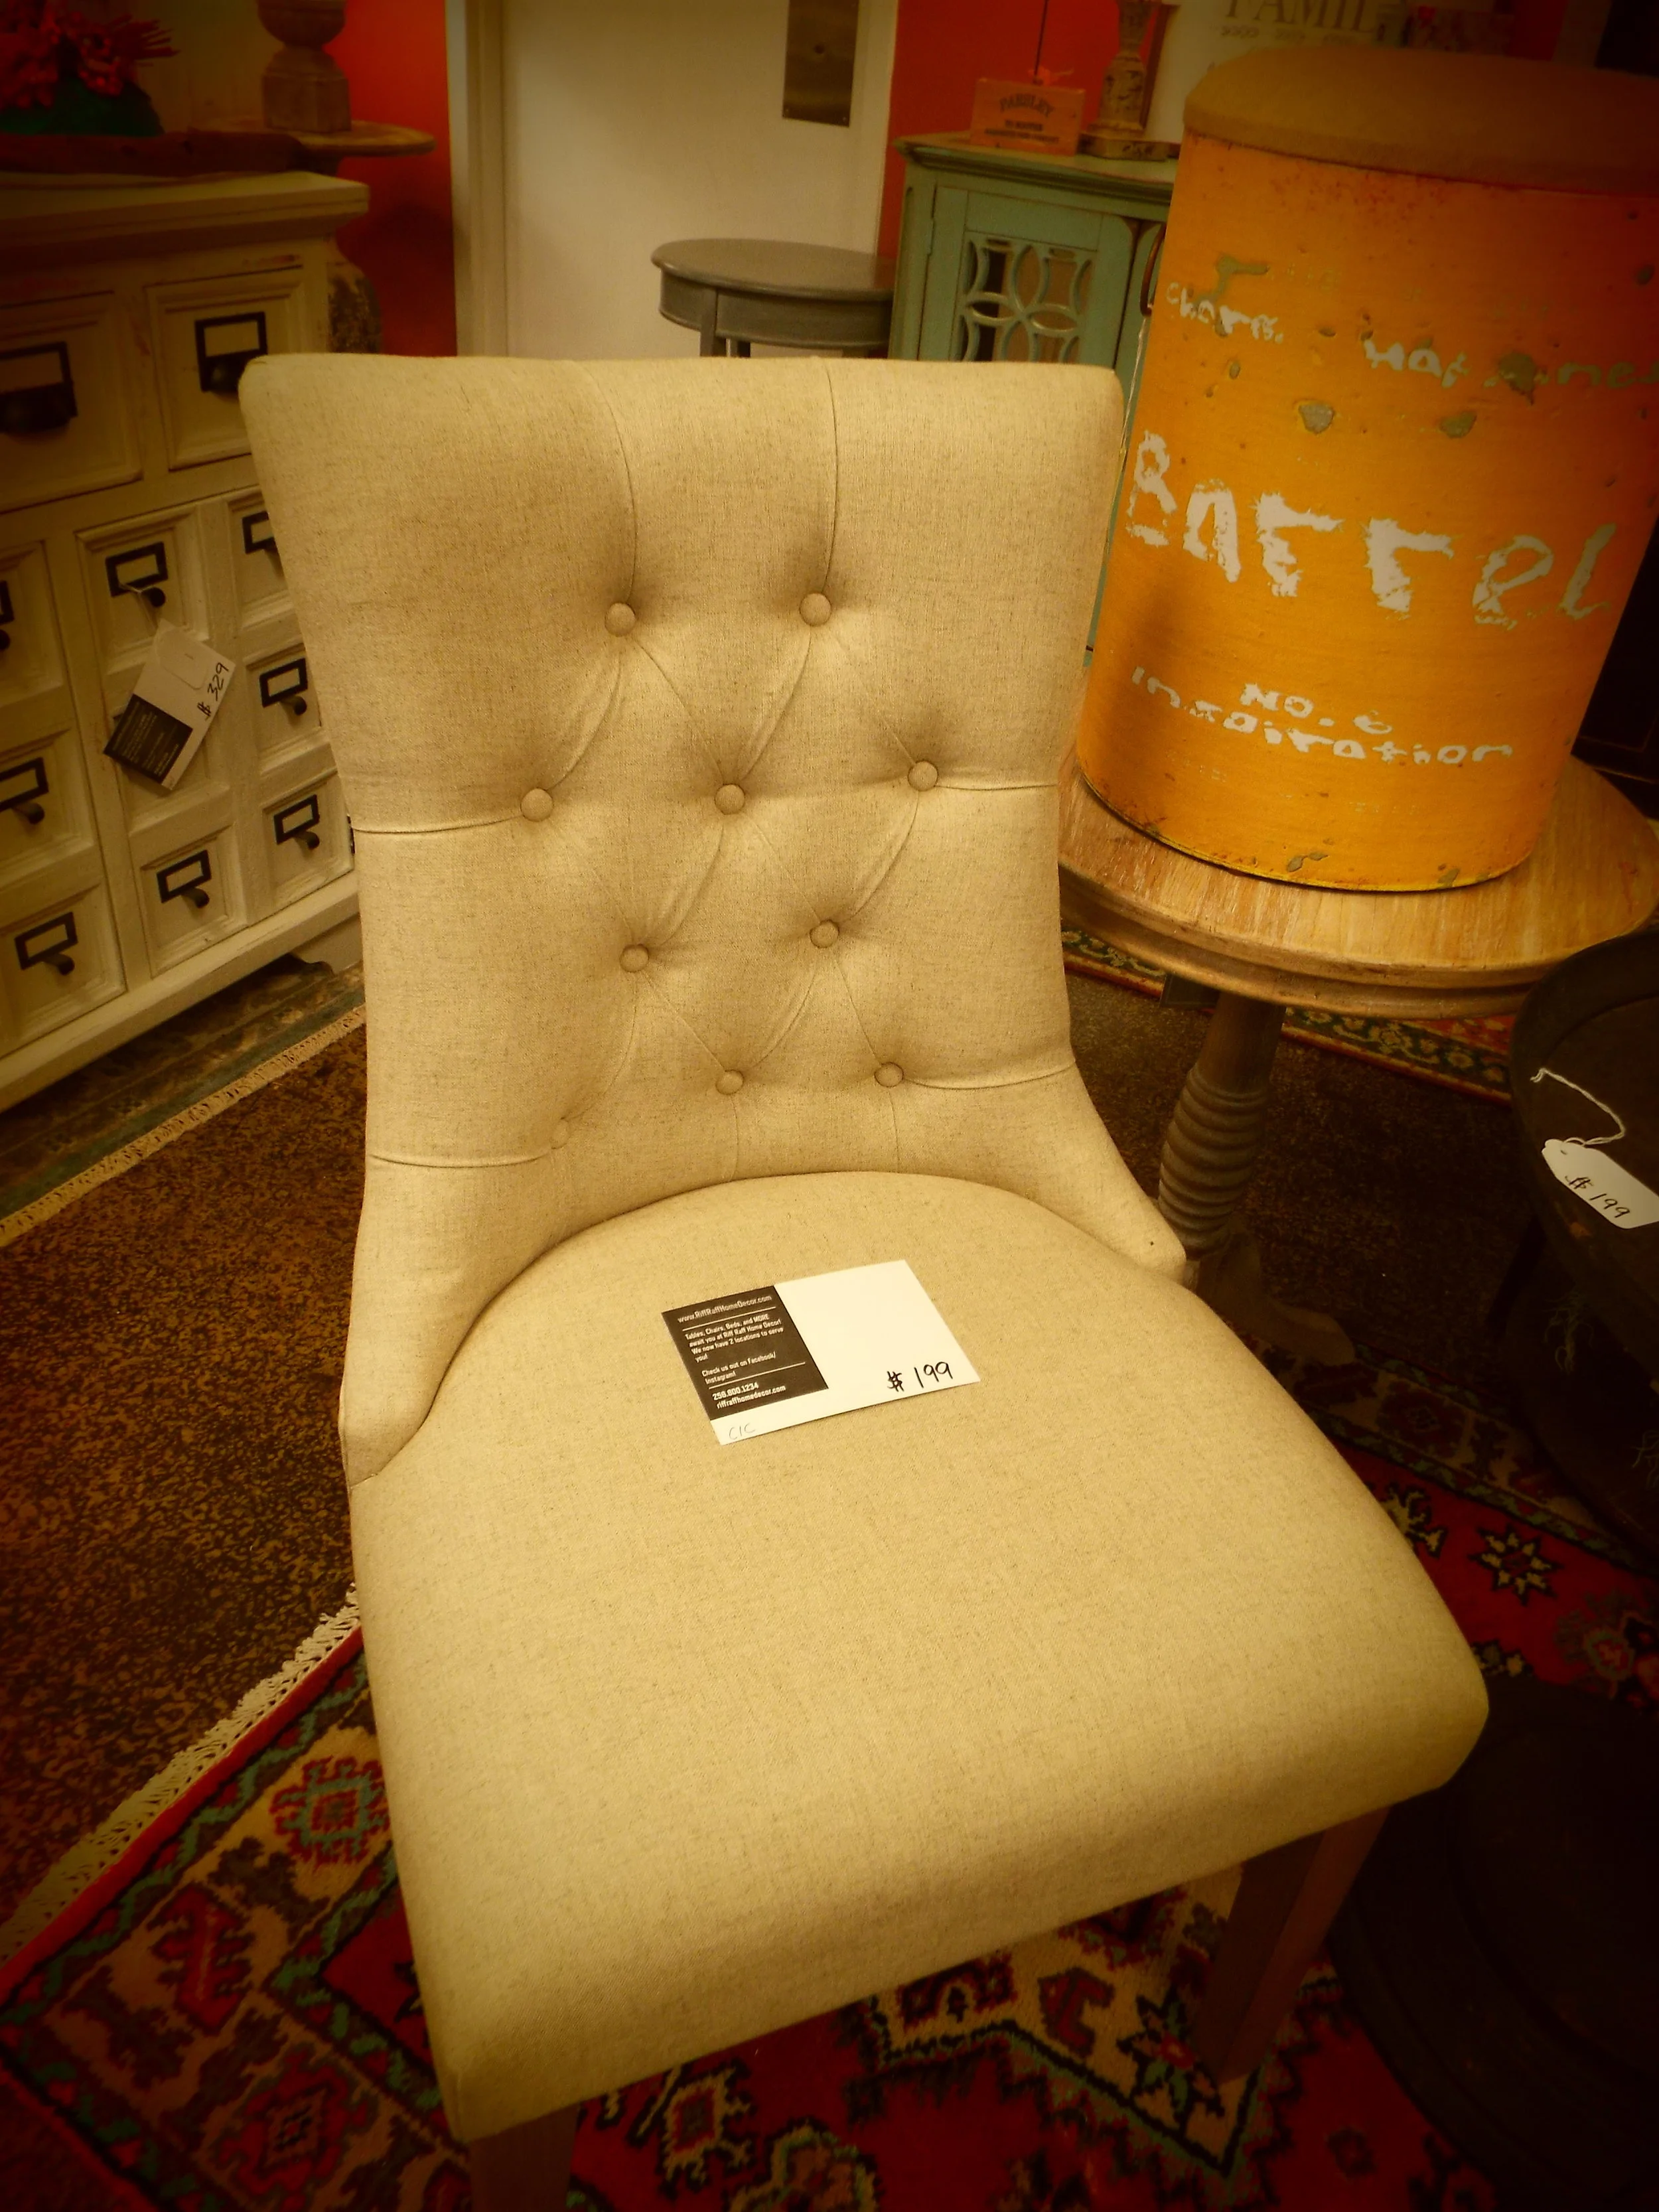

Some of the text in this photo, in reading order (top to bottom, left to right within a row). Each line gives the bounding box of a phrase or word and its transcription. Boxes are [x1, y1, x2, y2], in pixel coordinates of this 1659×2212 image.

[1589, 1193, 1630, 1218] 199
[753, 1313, 769, 1323] MORE
[689, 1338, 707, 1347] await
[747, 1324, 762, 1333] Home
[762, 1319, 782, 1328] Decor!
[714, 1340, 729, 1349] have
[735, 1332, 760, 1343] locations
[695, 1353, 708, 1363] you!
[701, 1366, 720, 1377] Check
[705, 1370, 737, 1384] Instagram!
[914, 1361, 953, 1388] 199
[717, 1385, 786, 1409] riffraffhomedecor.com
